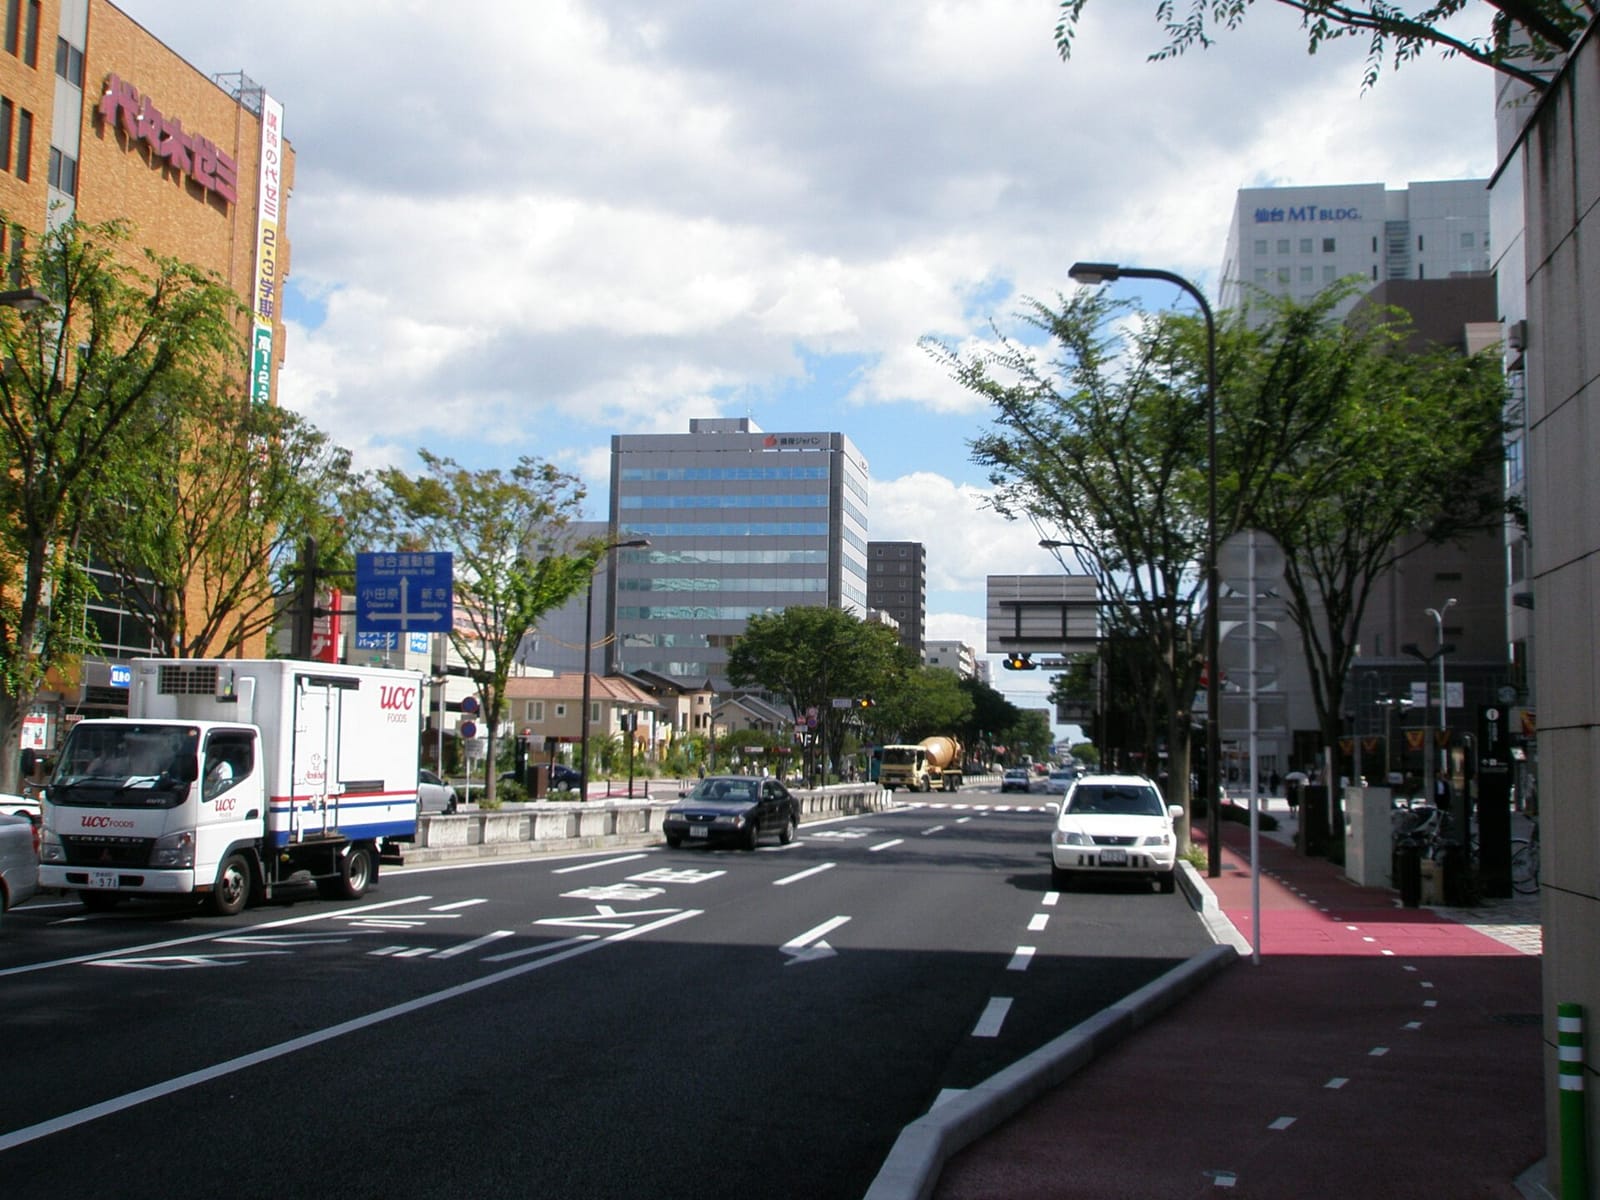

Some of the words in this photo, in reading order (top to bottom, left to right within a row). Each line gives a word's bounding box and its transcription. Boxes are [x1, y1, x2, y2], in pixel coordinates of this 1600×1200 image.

[100, 73, 237, 205] 代々木ゼミ
[362, 588, 398, 601] 小田原
[380, 686, 416, 710] UCC
[215, 798, 237, 812] UCC
[81, 815, 110, 828] UCC
